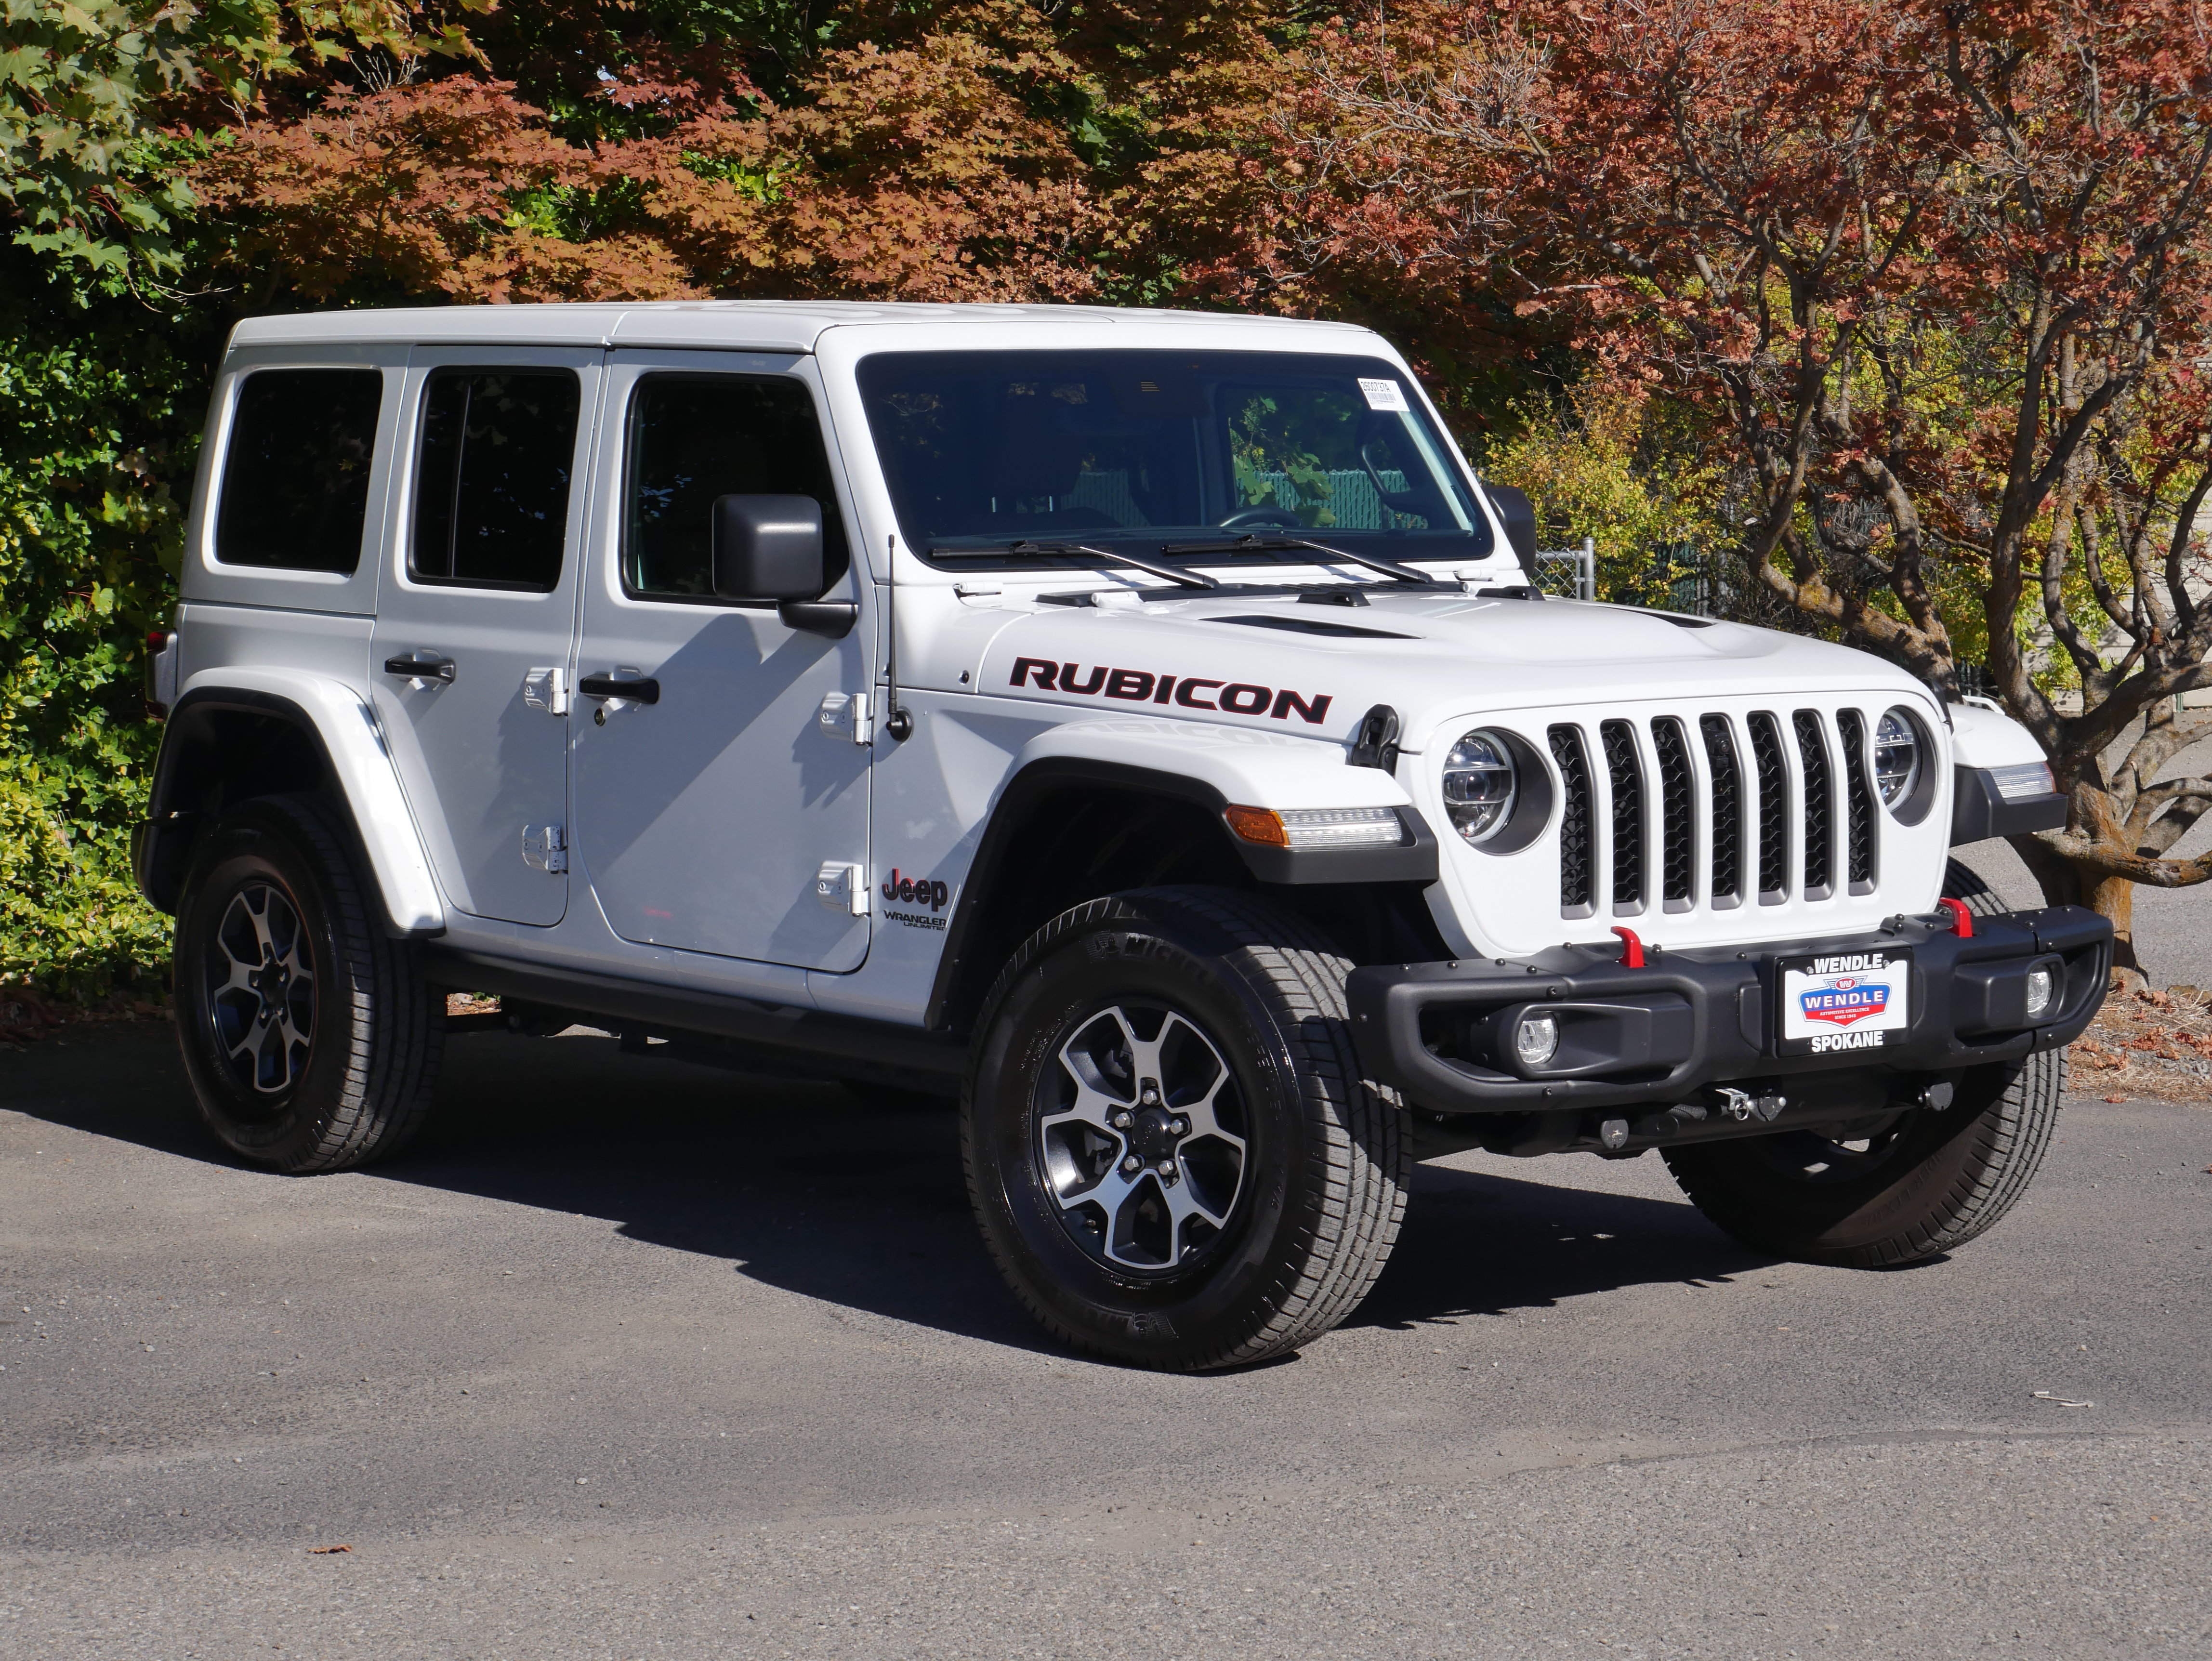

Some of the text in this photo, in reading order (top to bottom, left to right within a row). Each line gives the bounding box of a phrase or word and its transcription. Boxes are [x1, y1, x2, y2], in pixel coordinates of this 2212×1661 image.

[1009, 656, 1333, 725] RUBICON
[882, 868, 948, 912] Jeep
[883, 910, 947, 926] WRANGLER
[1814, 953, 1883, 974] WENDLE
[1805, 990, 1883, 1008] WENDLE
[1812, 1031, 1883, 1052] SPOKANE
